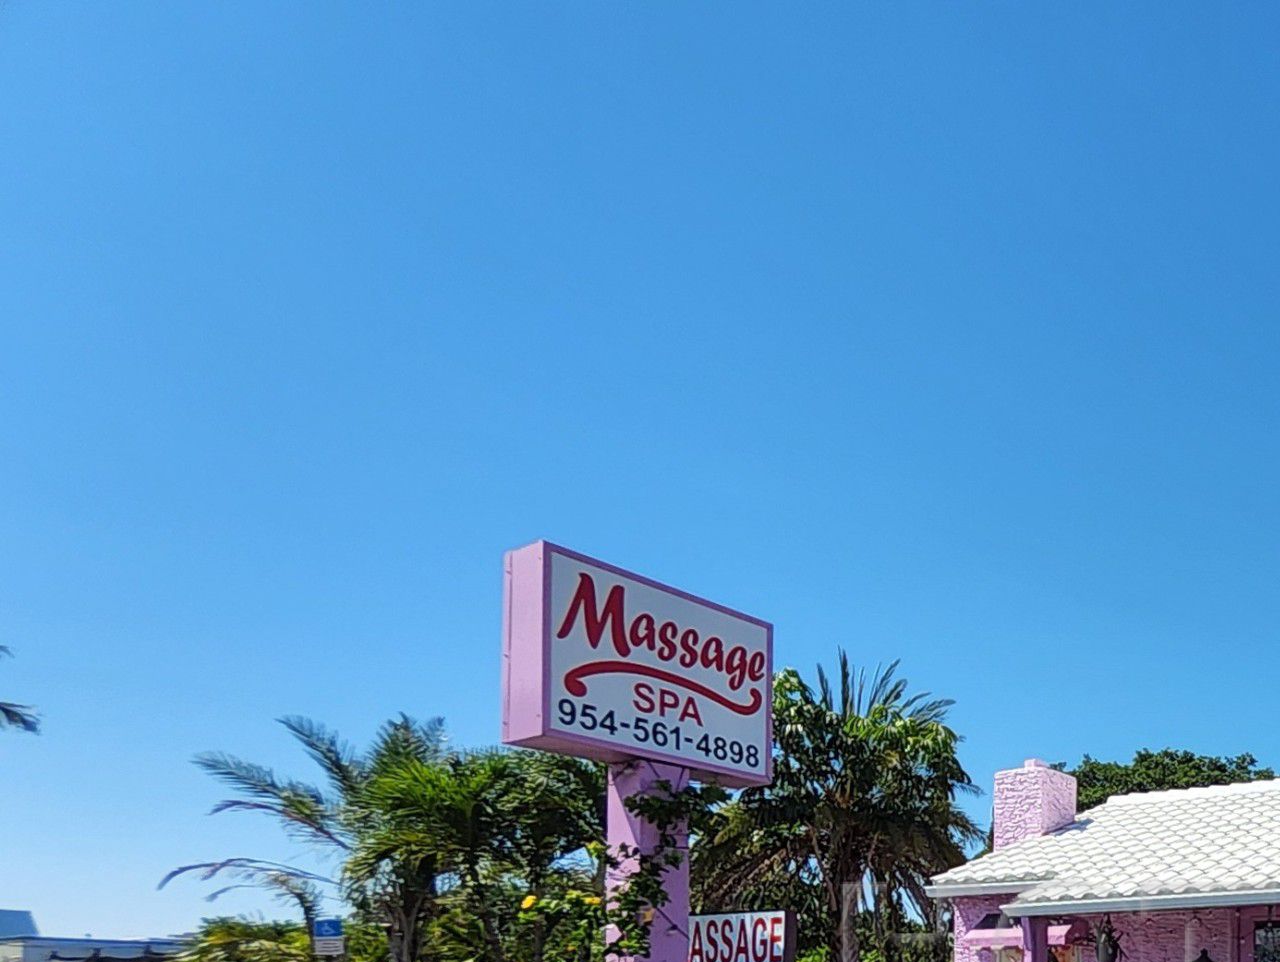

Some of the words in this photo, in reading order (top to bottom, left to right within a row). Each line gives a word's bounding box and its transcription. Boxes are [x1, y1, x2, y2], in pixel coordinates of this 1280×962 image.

[557, 572, 765, 691] Massage
[558, 698, 760, 768] 954-561-4898
[633, 682, 703, 727] SPA
